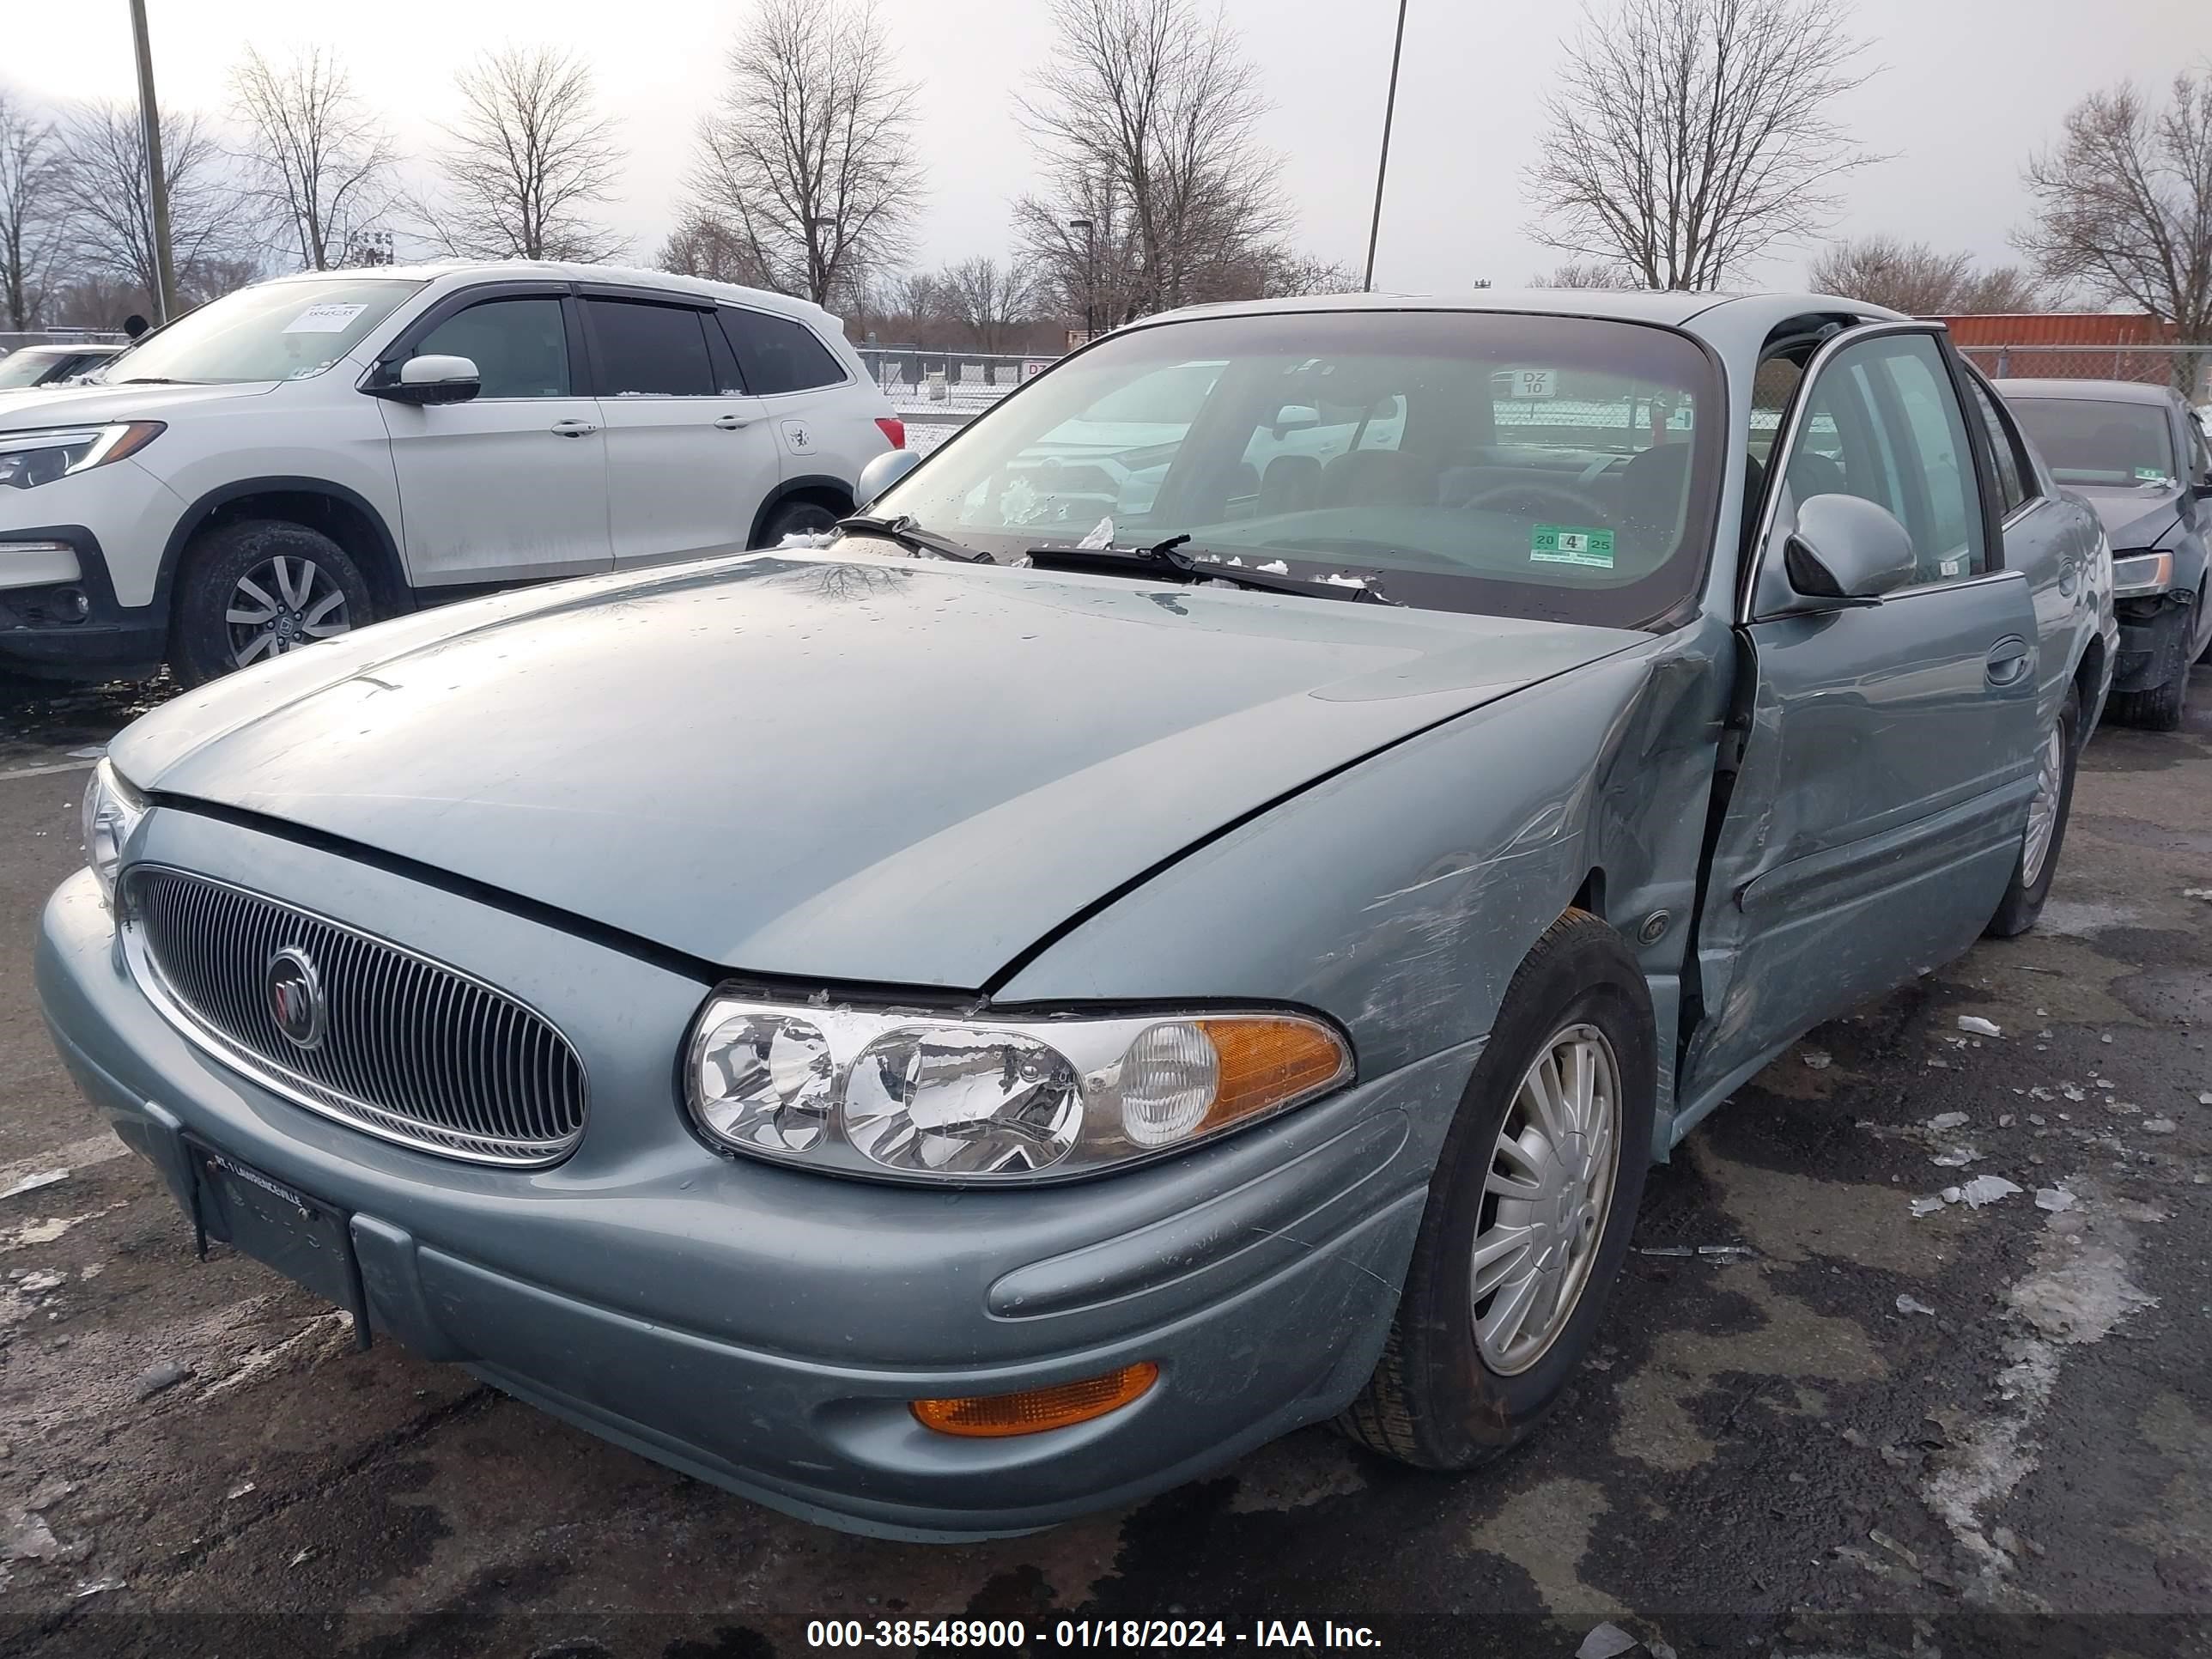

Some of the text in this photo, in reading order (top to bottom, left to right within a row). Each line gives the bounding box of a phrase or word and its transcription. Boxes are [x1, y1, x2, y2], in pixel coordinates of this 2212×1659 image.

[1523, 373, 1547, 383] DZ
[1524, 383, 1543, 393] 10
[1536, 535, 1611, 550] 20 4 25
